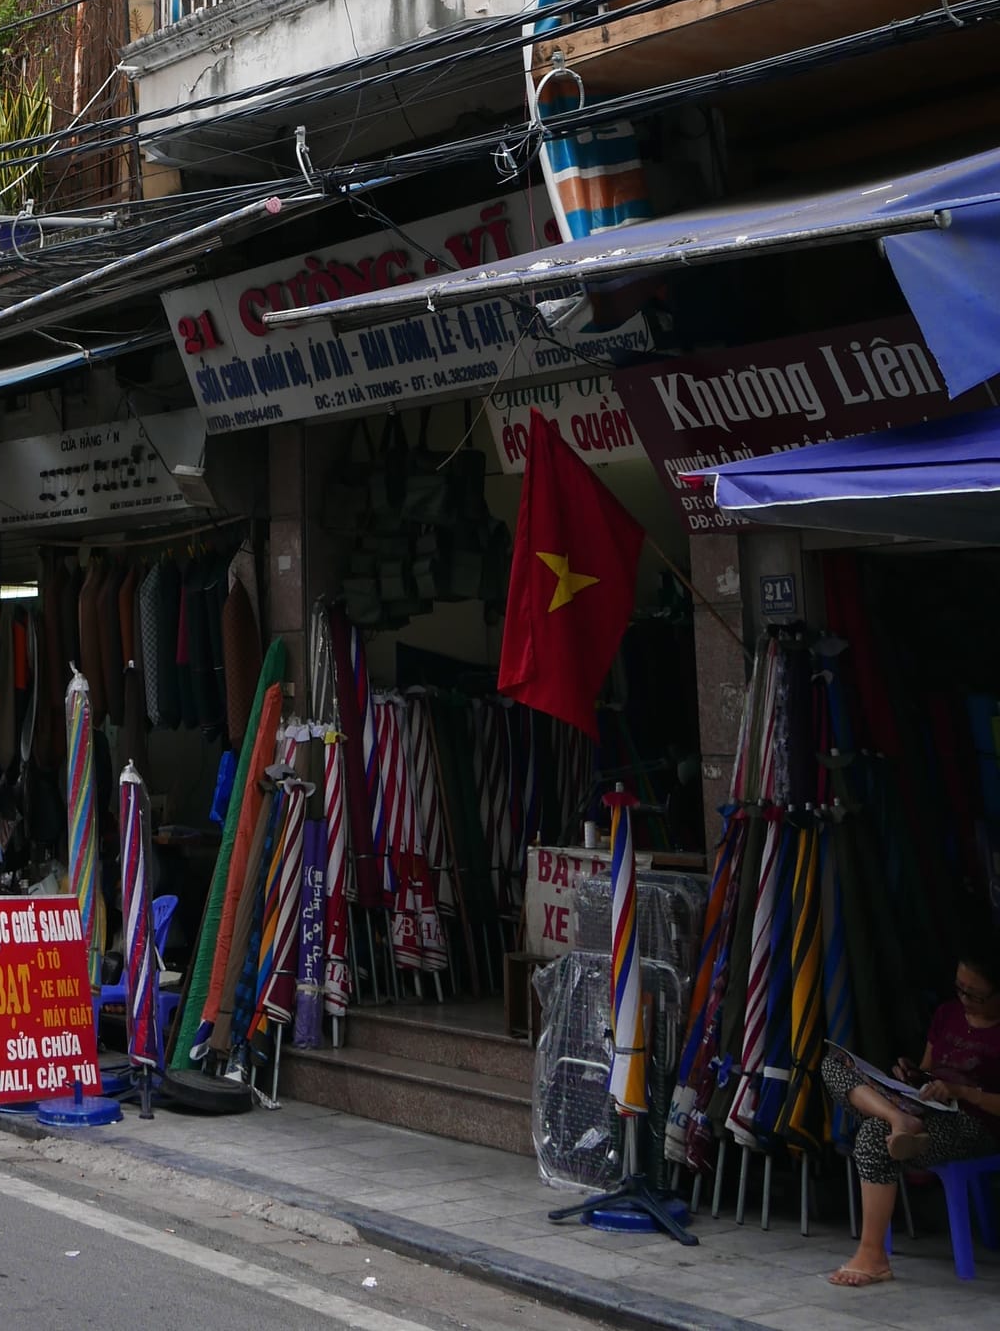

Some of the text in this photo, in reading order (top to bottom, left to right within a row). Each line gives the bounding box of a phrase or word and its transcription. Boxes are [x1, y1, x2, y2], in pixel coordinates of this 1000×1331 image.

[178, 309, 224, 355] 21
[308, 336, 331, 381] ÁO
[348, 383, 366, 403] HÀ
[366, 379, 402, 401] TRUNG
[651, 336, 944, 433] Khương Liên
[80, 431, 103, 450] HÀNG
[11, 901, 39, 944] GHẾ
[39, 909, 83, 943] SALON
[542, 903, 570, 944] XE
[36, 948, 45, 970] Ô
[46, 947, 61, 970] TÔ
[40, 979, 55, 1000] XE
[56, 974, 80, 998] MÁY
[42, 1004, 68, 1028] MÁY
[69, 1003, 93, 1029] GIẶT
[6, 1030, 82, 1061] SỬA CHỮA
[71, 1059, 98, 1086] TÚI
